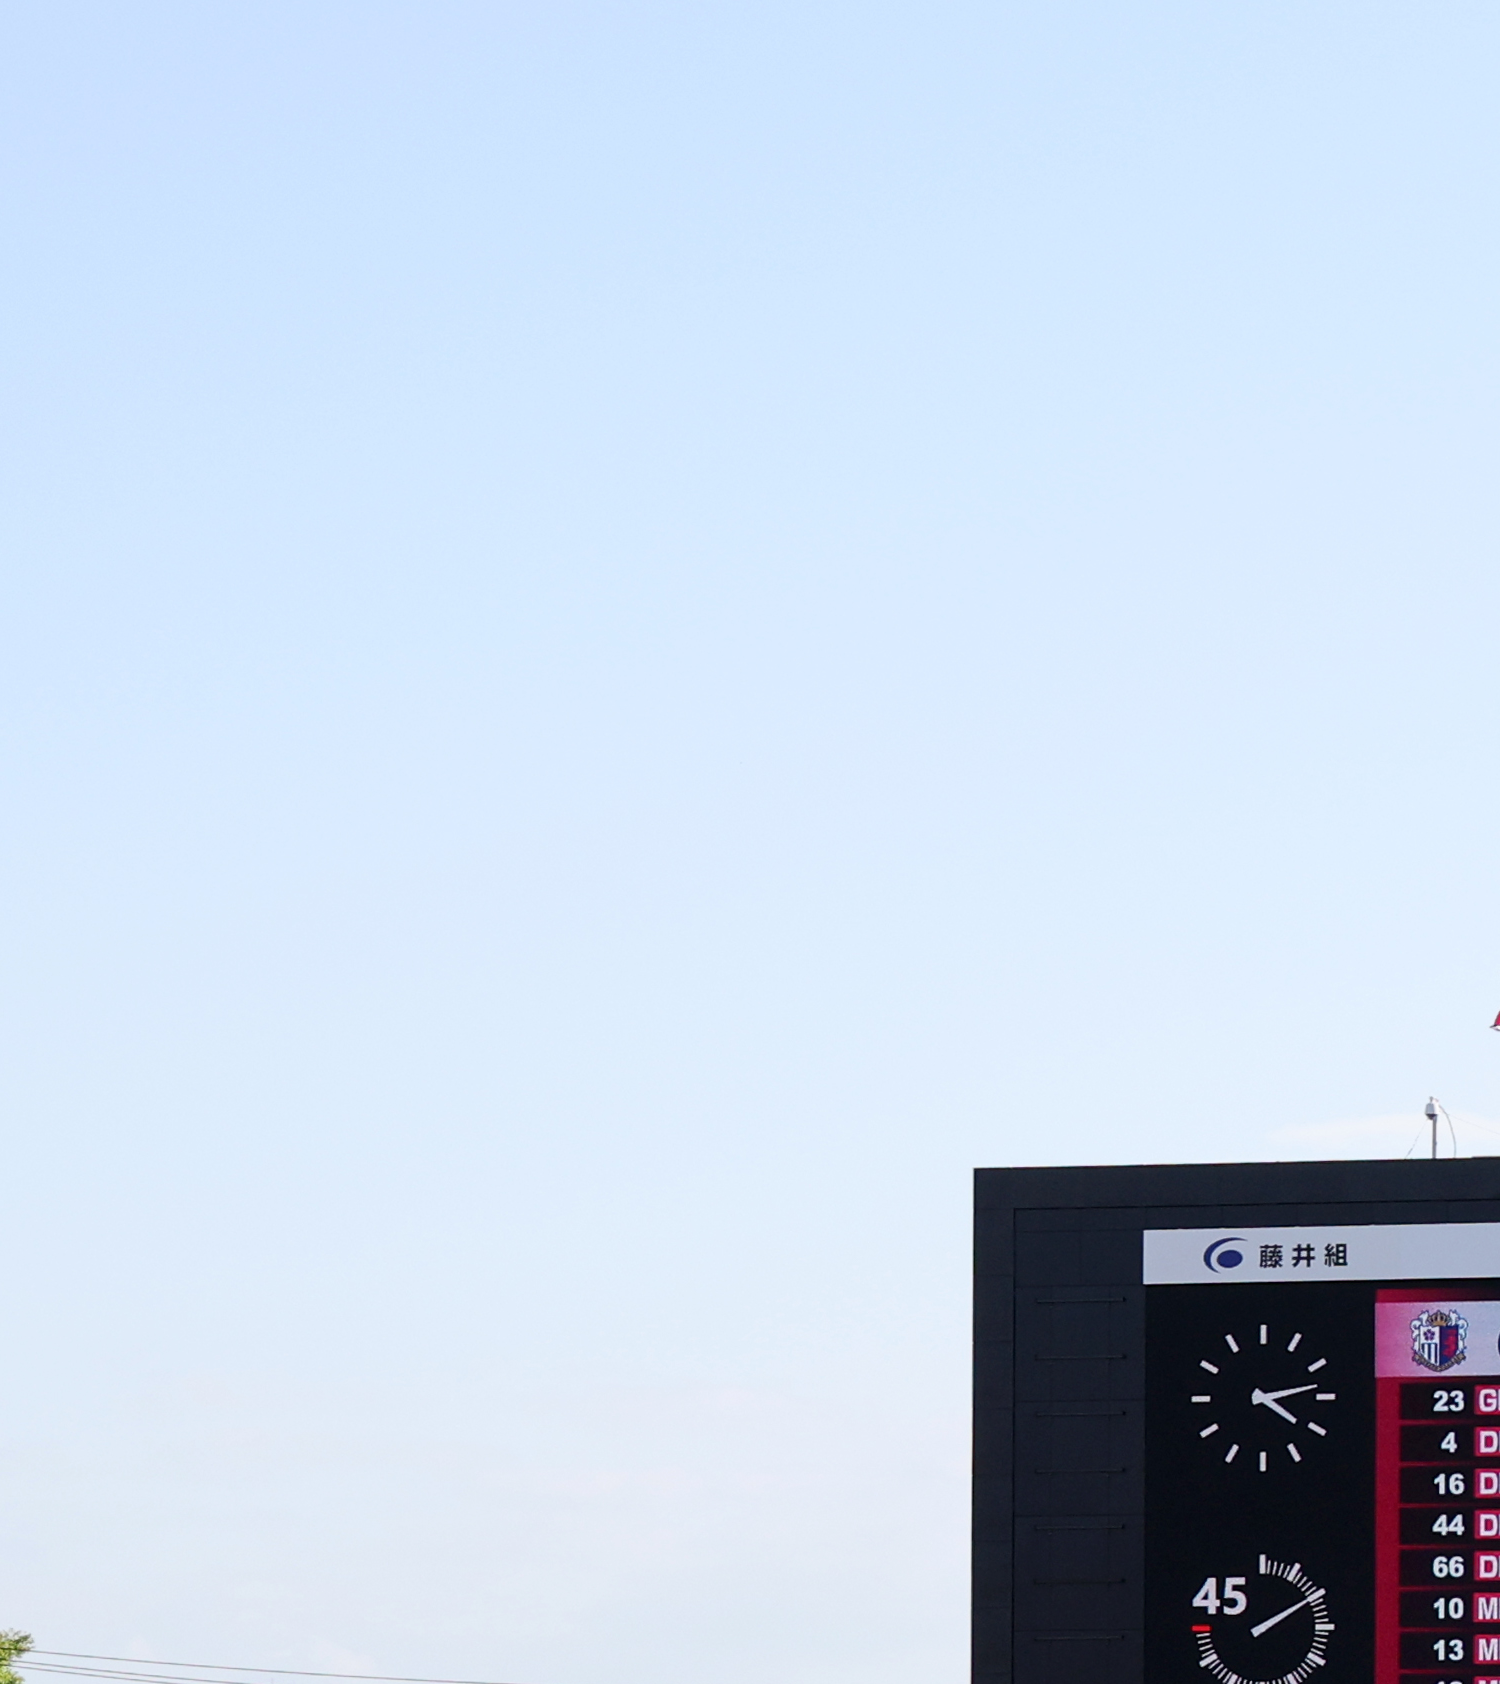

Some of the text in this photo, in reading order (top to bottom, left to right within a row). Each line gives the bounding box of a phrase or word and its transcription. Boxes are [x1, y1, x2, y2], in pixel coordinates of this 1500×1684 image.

[1259, 1243, 1348, 1269] 藤井組
[1433, 1390, 1465, 1412] 23
[1440, 1431, 1458, 1453] 4
[1433, 1473, 1465, 1495] 16
[1432, 1513, 1465, 1536] 44
[1432, 1555, 1465, 1578] 66
[1192, 1576, 1247, 1616] 45
[1433, 1597, 1464, 1620] 10
[1433, 1639, 1464, 1661] 13
